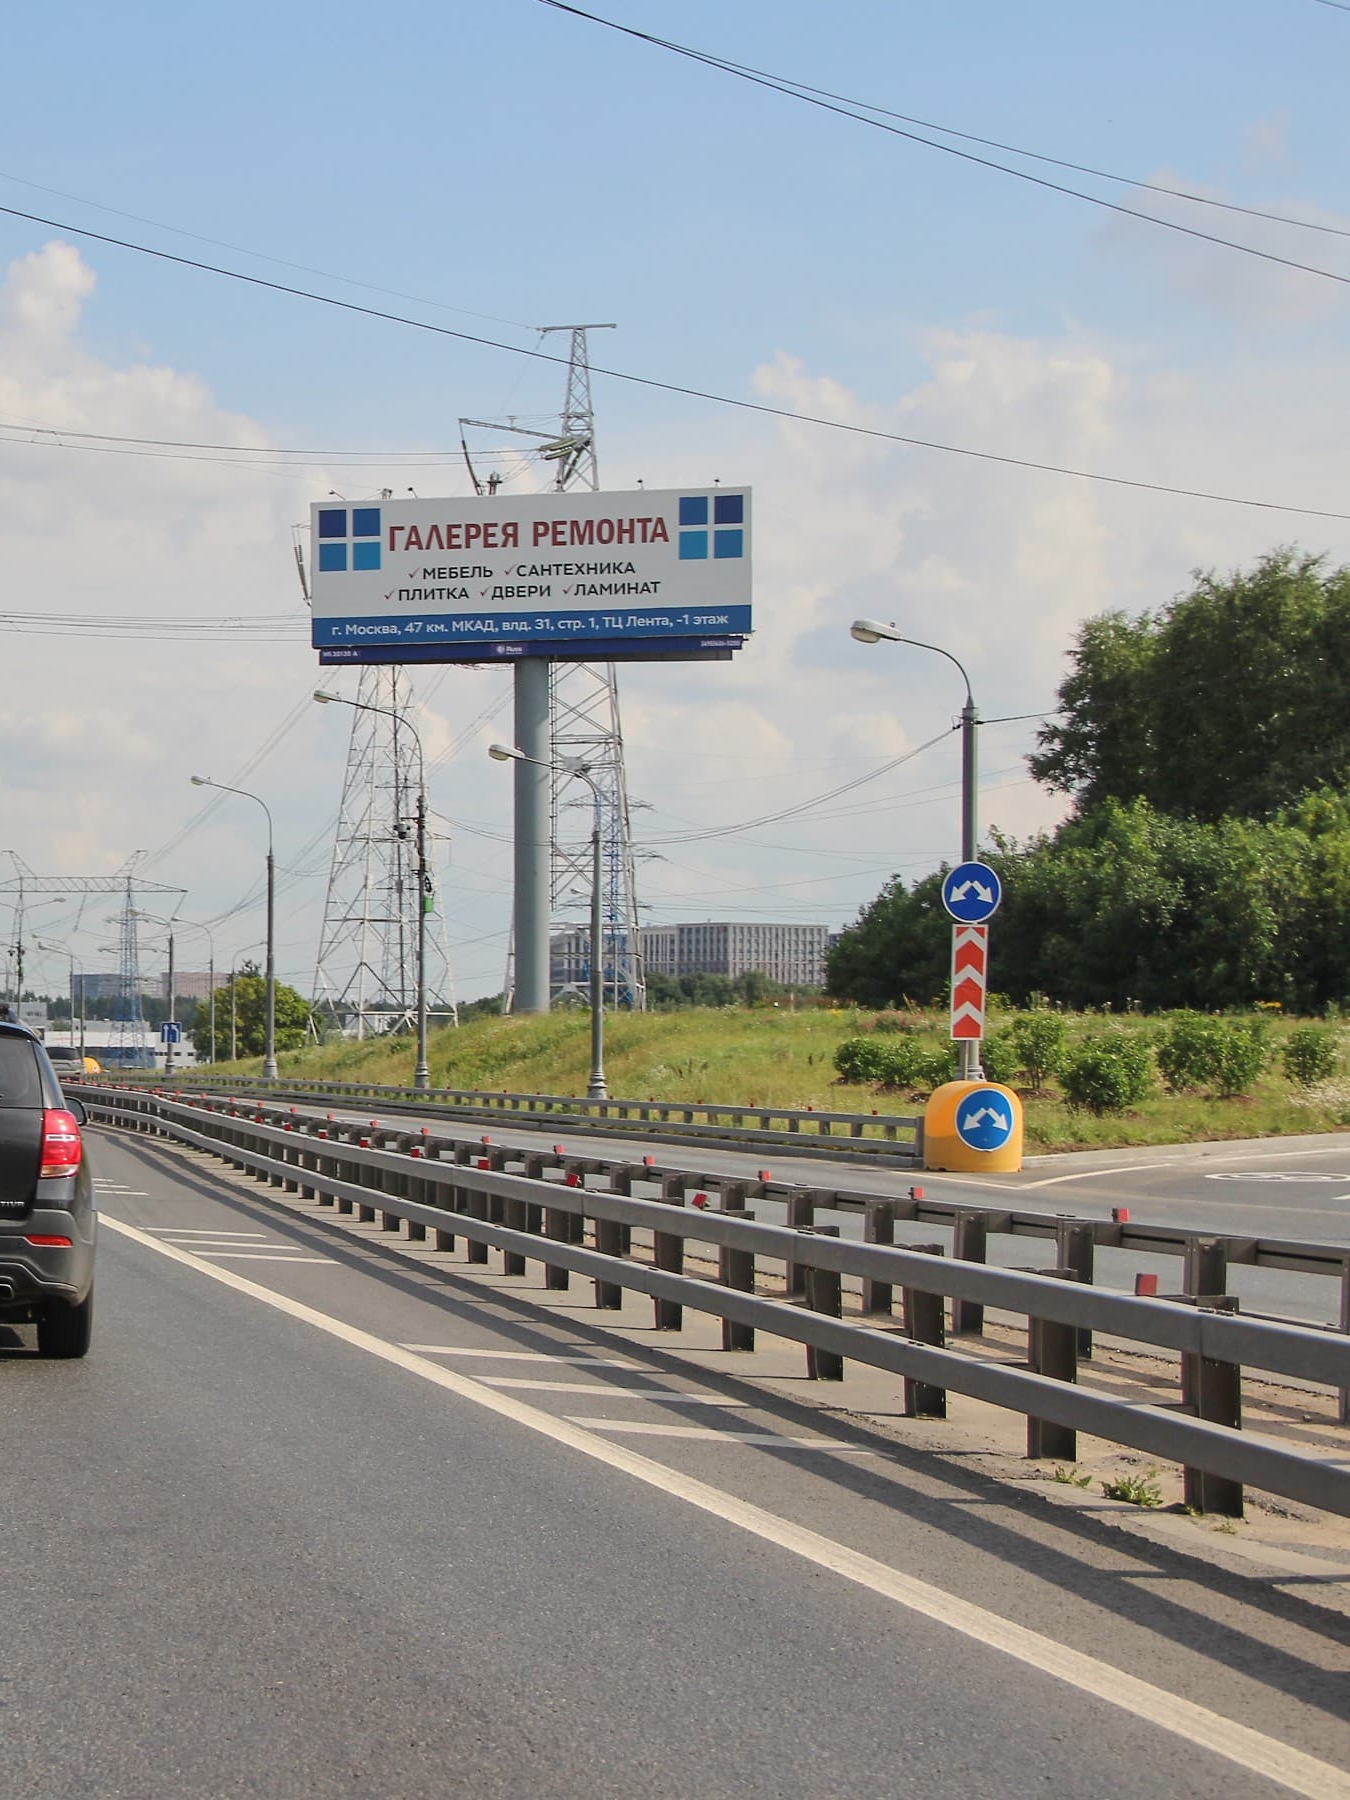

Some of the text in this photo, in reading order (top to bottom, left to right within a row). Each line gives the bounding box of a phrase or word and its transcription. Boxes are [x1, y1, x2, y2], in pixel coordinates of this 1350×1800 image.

[389, 517, 670, 552] ГАЛЕРЕЯ РЕМОНТА
[422, 561, 636, 580] МЕБЕЛЬ САНТЕХНИКА
[398, 581, 661, 601] ПЛИТКА ДВЕРИ ЛАМИНАТ
[331, 626, 342, 636] г.
[345, 624, 402, 637] Москва,
[404, 621, 423, 633] 47
[426, 623, 449, 633] км.
[451, 619, 499, 633] МКАД,
[502, 620, 532, 632] влд.
[534, 618, 555, 631] 31,
[557, 619, 586, 631] стр.
[602, 616, 623, 629] ТЦ
[625, 615, 674, 628] Лента,
[676, 614, 689, 625] -1
[693, 615, 729, 625] этаж
